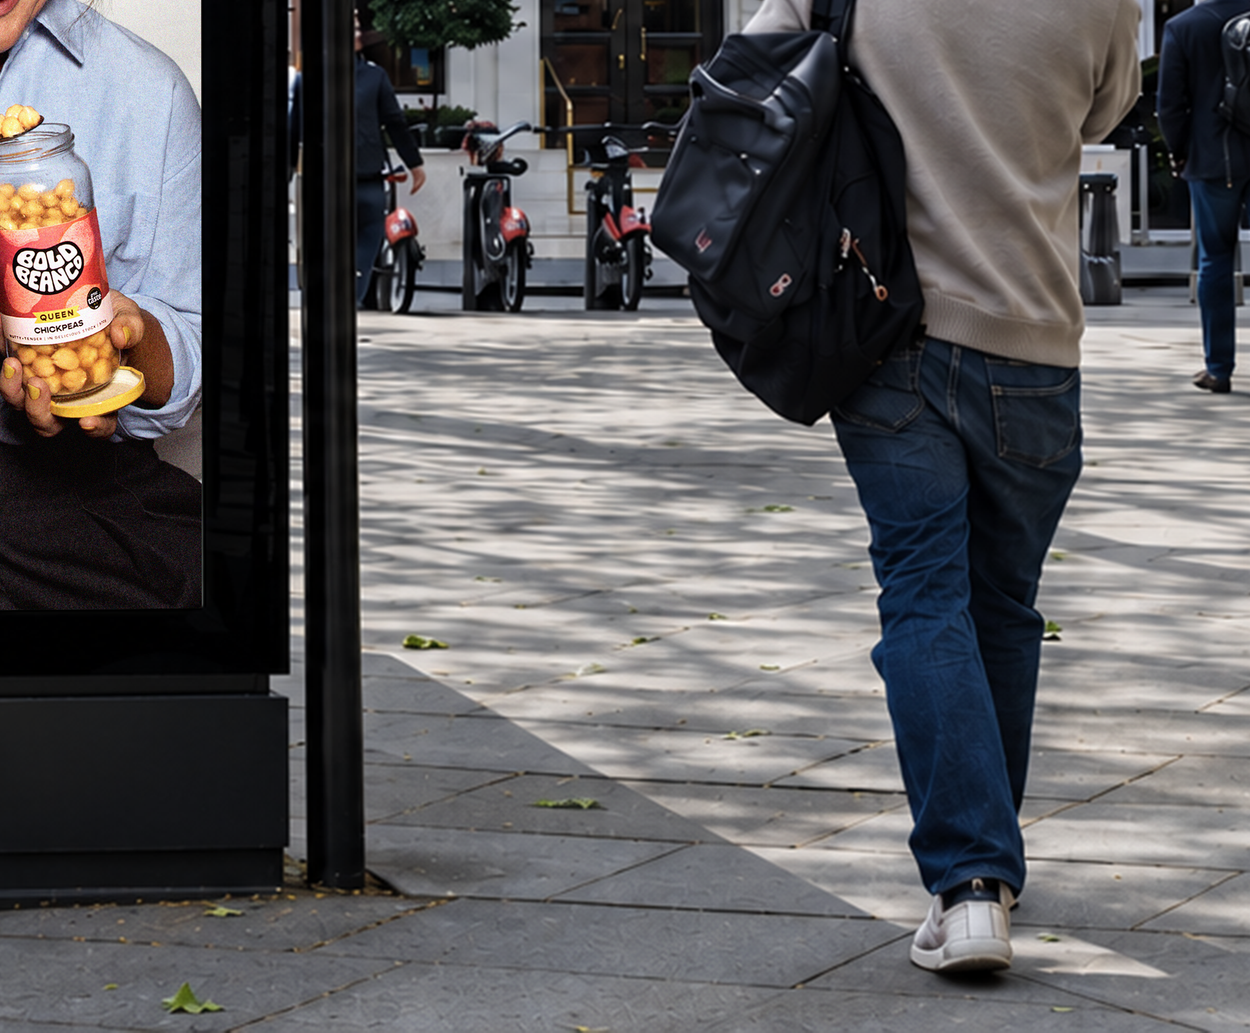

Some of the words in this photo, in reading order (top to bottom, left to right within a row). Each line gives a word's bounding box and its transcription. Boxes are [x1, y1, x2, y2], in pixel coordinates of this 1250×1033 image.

[16, 243, 78, 271] BOLD
[39, 309, 74, 321] QUEEN
[34, 319, 84, 334] CHICKPEAS
